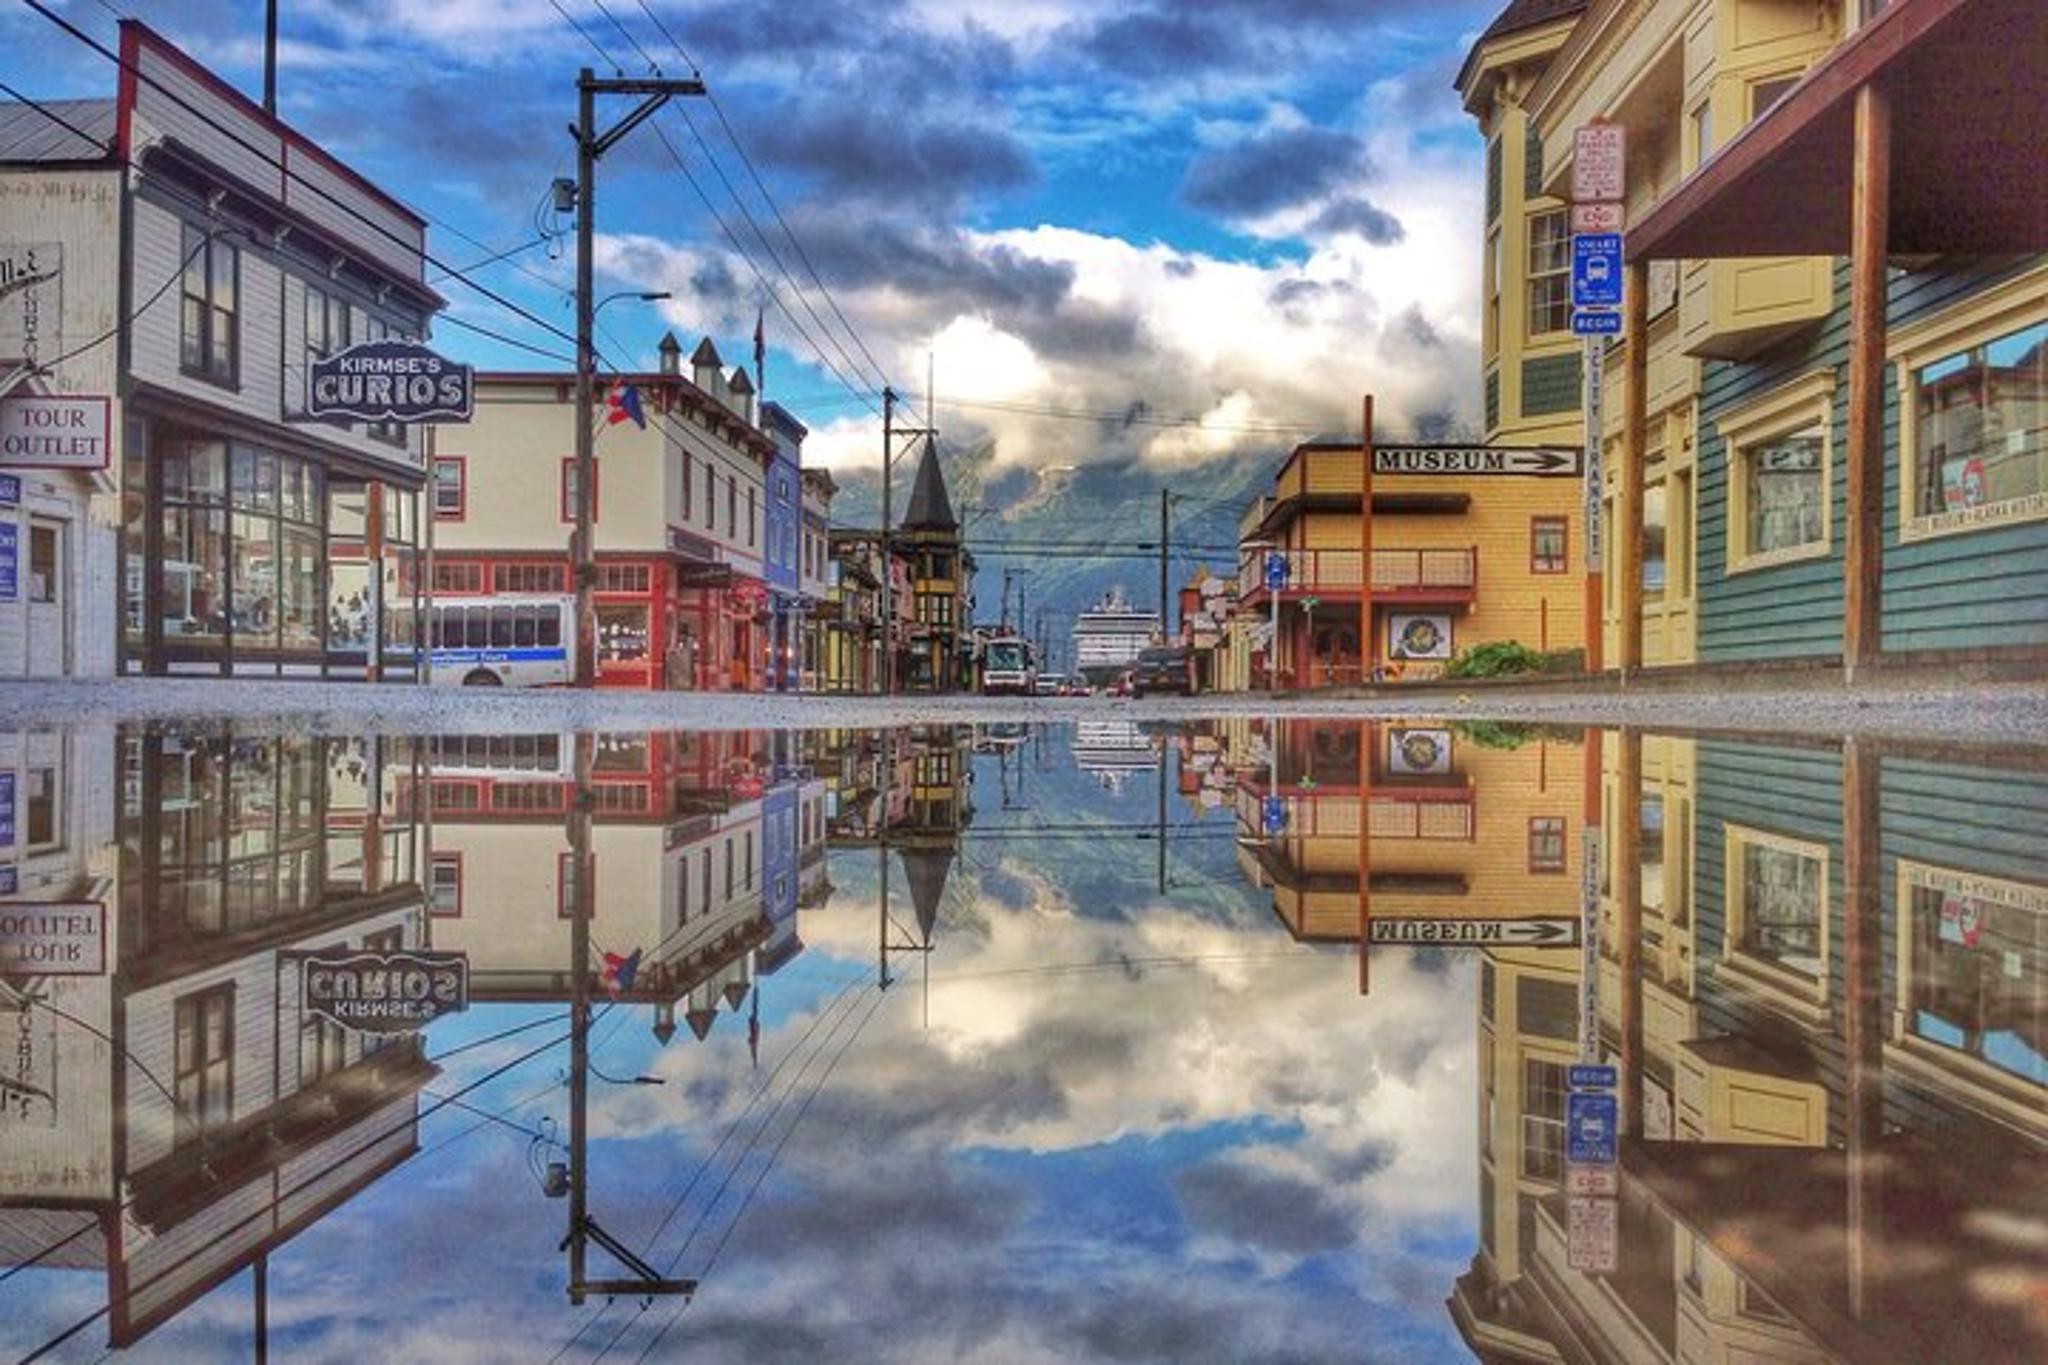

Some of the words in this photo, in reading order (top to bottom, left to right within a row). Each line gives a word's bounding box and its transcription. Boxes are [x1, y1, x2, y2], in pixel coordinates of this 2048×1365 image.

[1578, 317, 1618, 330] BEGIN
[339, 357, 442, 374] KIRMSE'S
[314, 373, 463, 405] CURIOS
[19, 408, 87, 428] TOUR
[4, 435, 104, 456] OUTLET
[1379, 450, 1506, 471] MUSEUM
